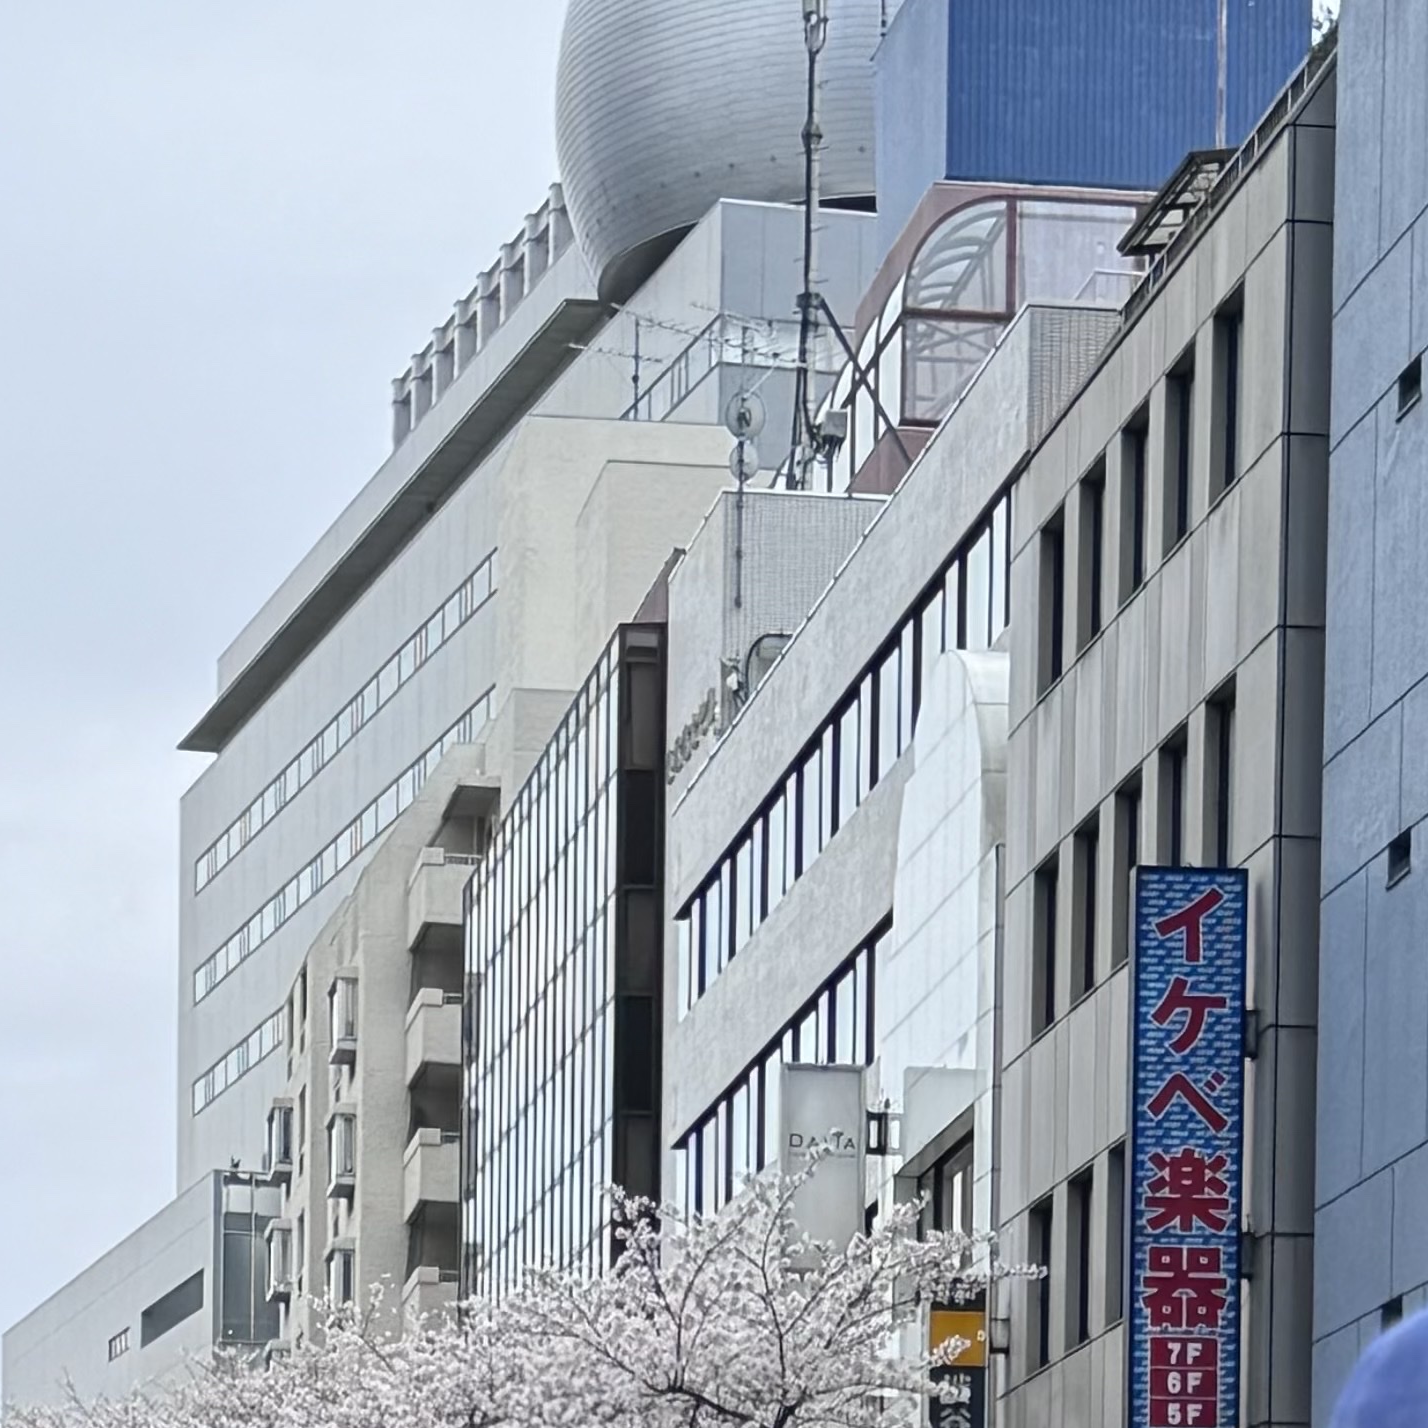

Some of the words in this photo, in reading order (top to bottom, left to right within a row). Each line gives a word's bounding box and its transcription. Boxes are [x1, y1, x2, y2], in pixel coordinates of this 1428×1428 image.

[1140, 887, 1230, 1329] イケベ楽器
[1166, 1341, 1203, 1365] 7F
[1166, 1371, 1203, 1394] 6F
[1166, 1402, 1203, 1425] 5F
